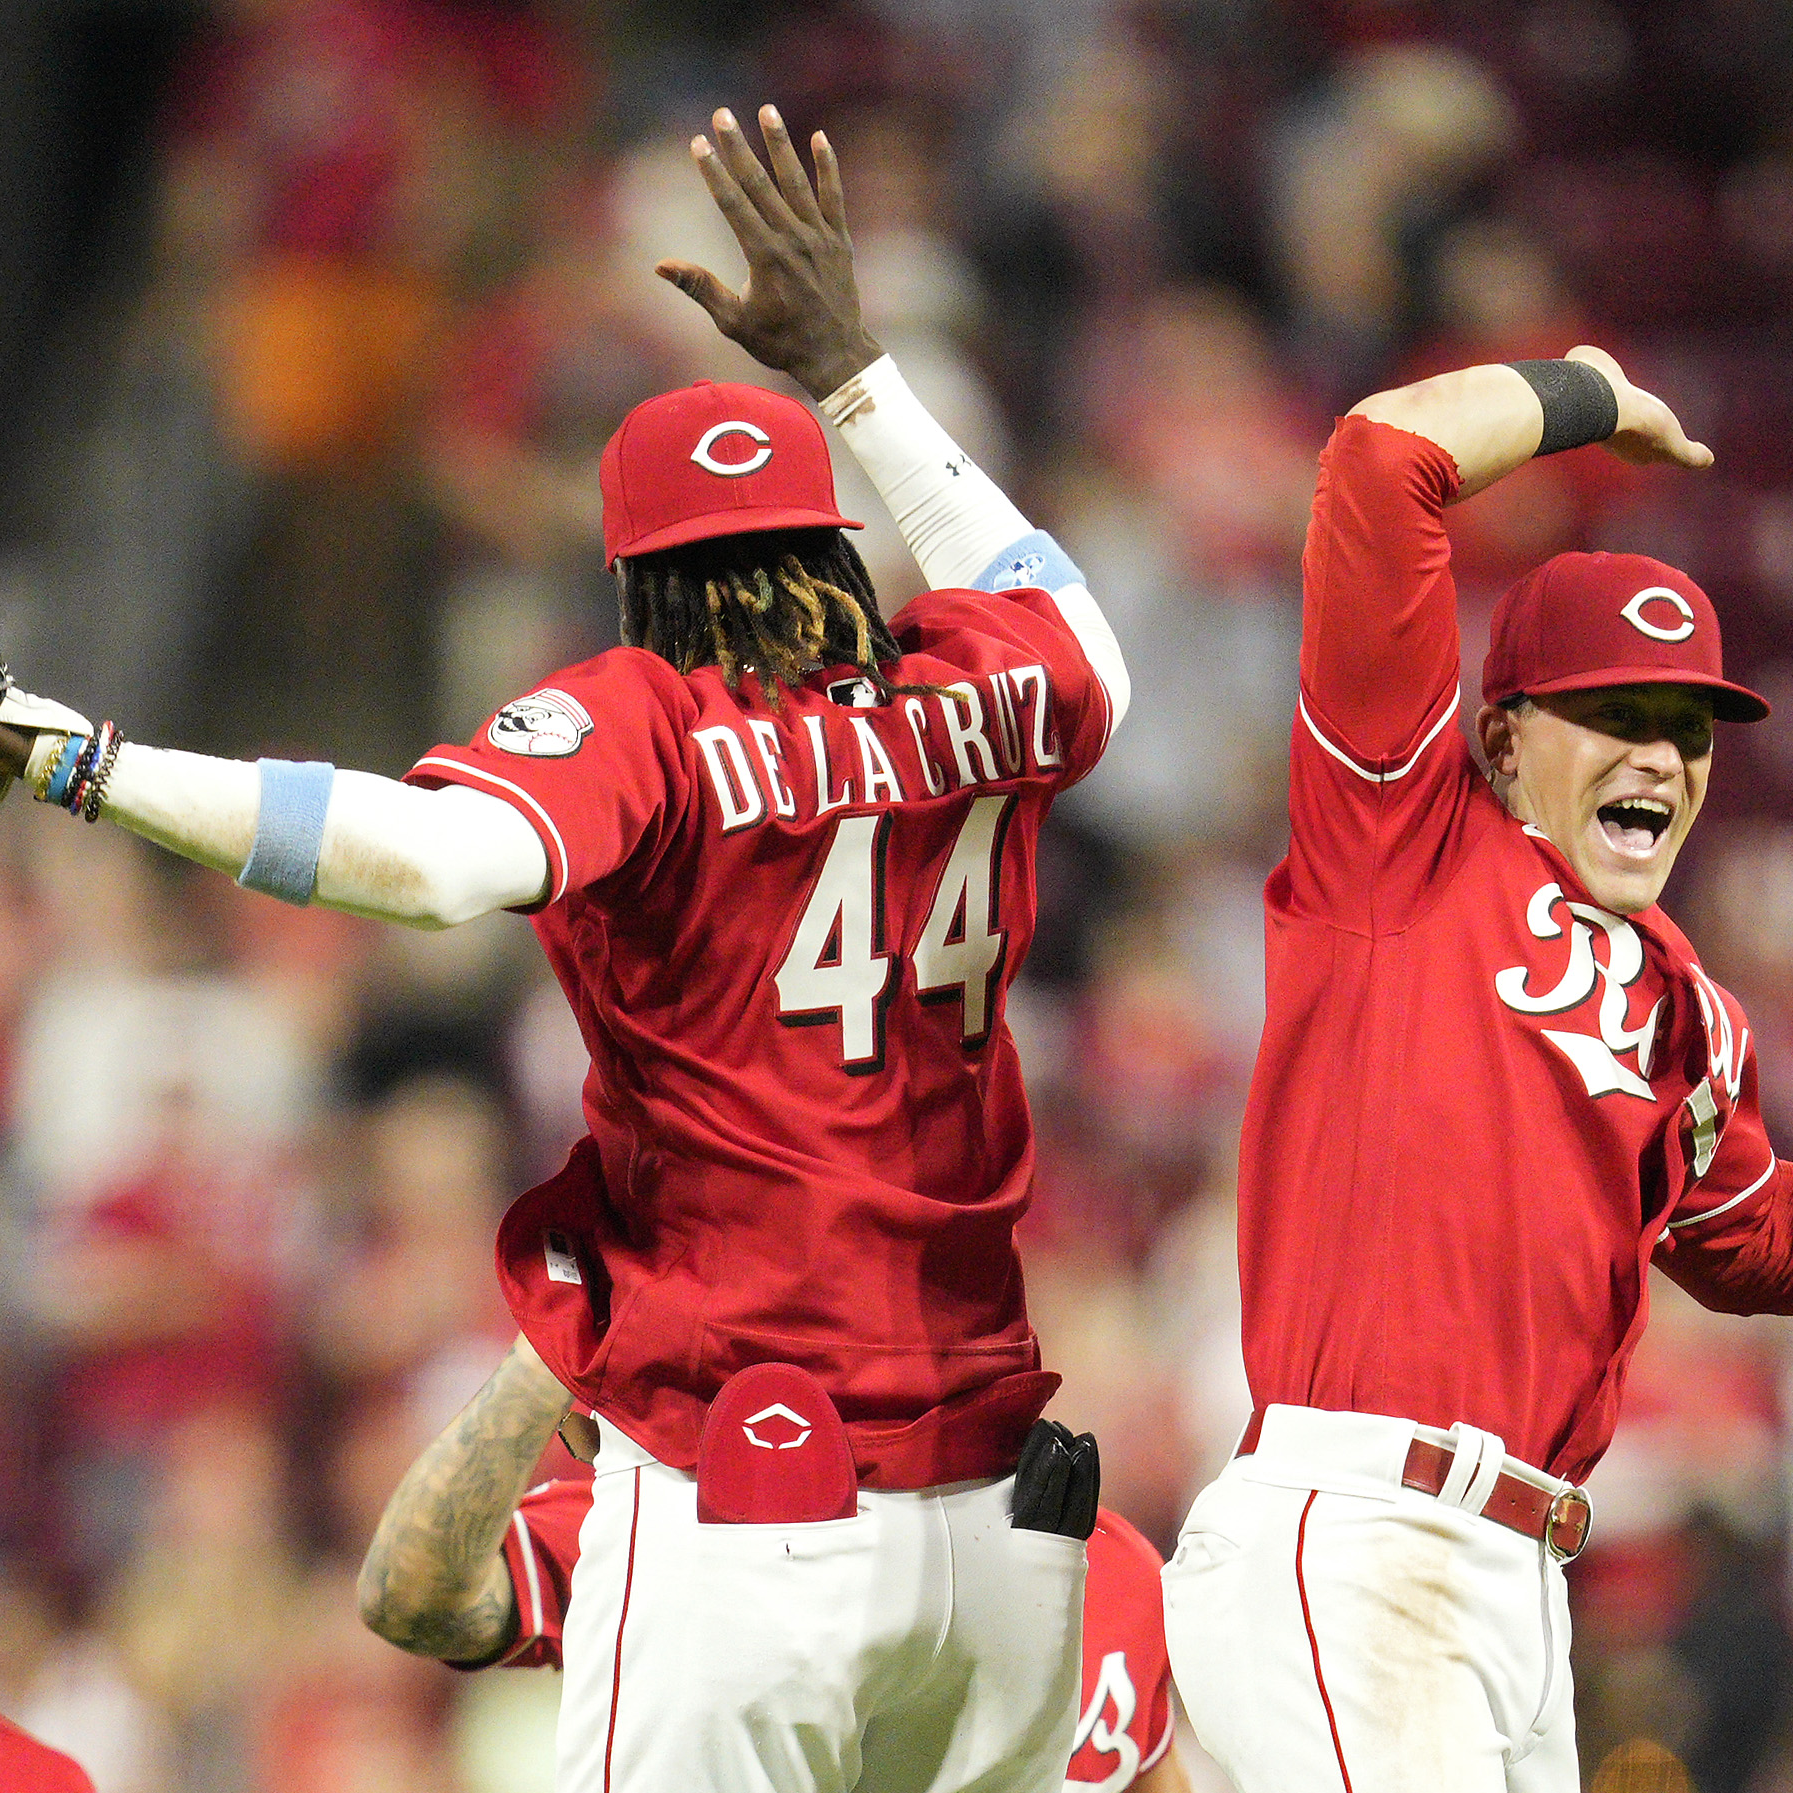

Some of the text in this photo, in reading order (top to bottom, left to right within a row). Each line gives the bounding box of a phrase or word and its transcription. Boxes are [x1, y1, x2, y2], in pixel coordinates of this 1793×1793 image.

[689, 419, 774, 479] C
[1619, 586, 1695, 645] C
[692, 663, 1063, 838] DE LA CRUZ
[769, 789, 1017, 1075] 44
